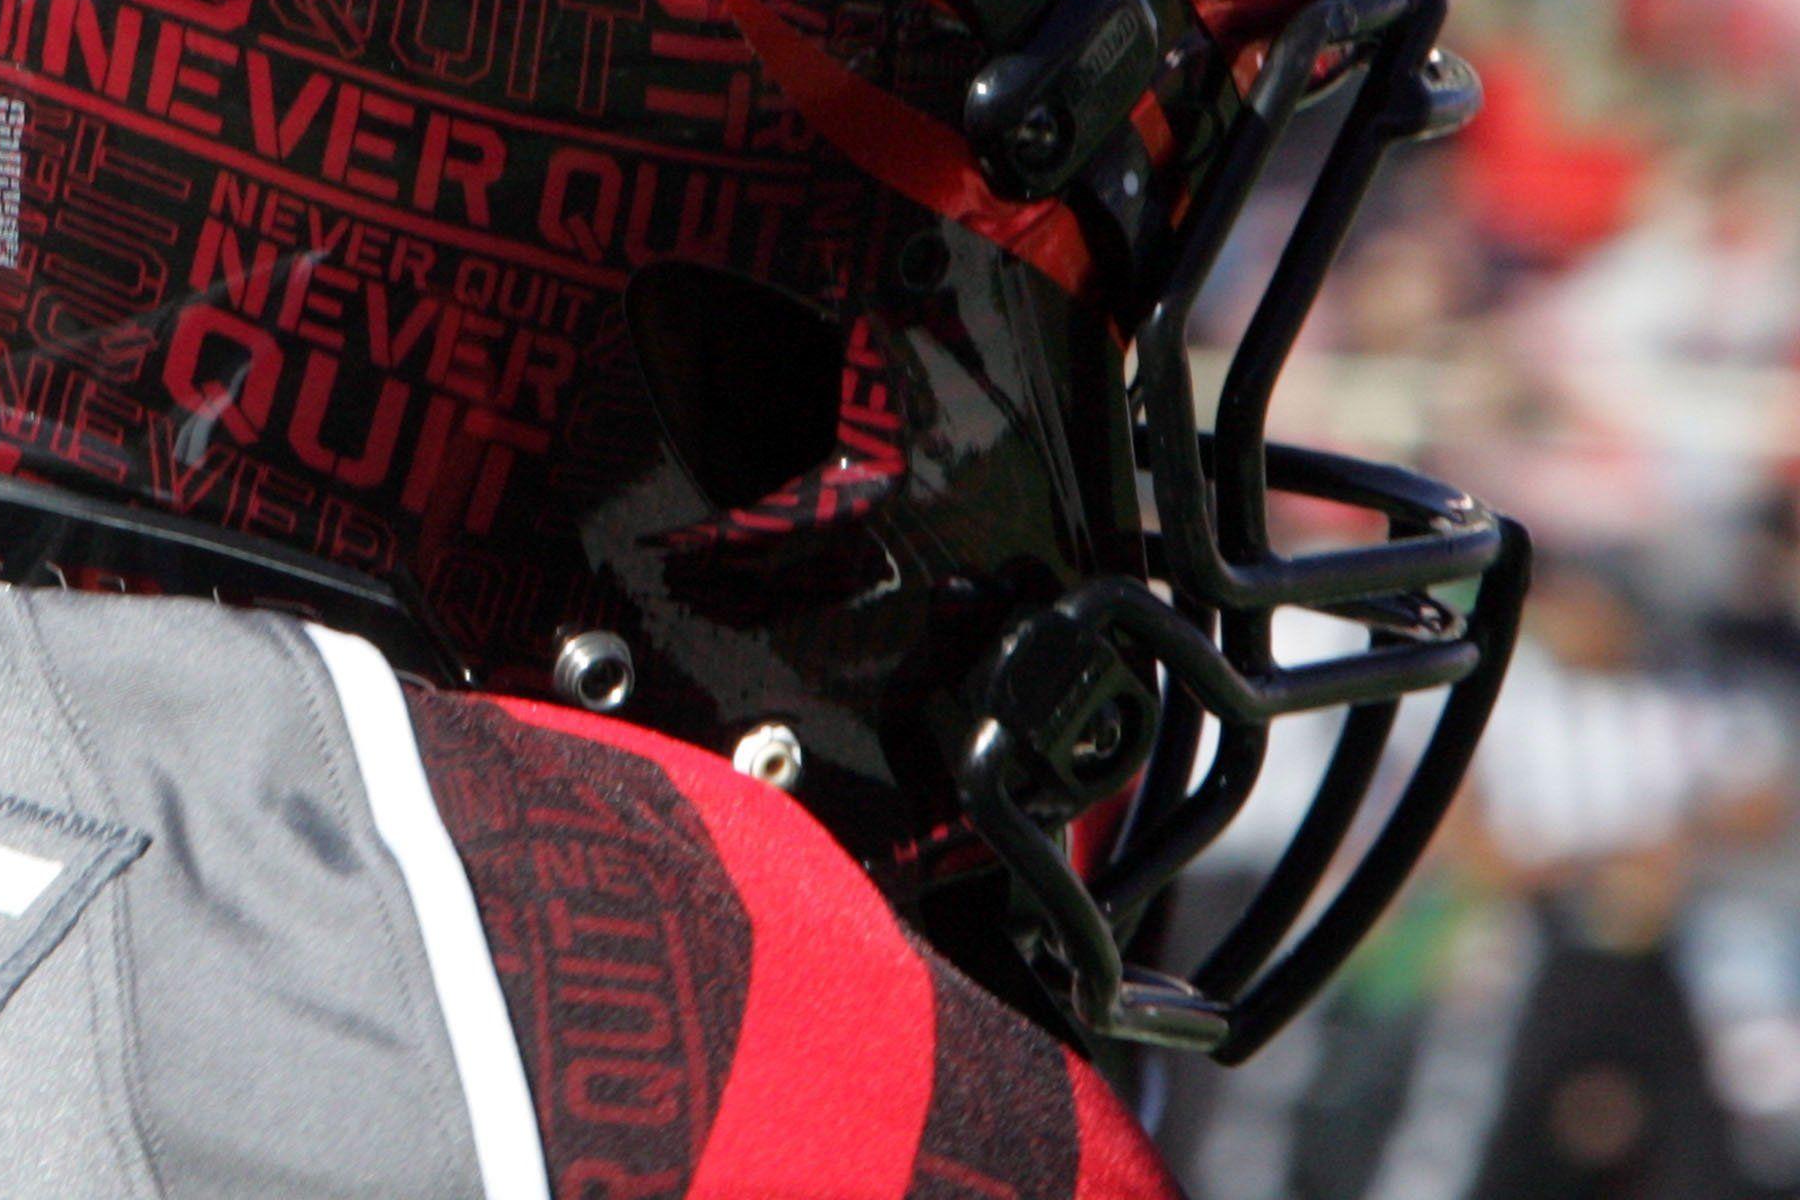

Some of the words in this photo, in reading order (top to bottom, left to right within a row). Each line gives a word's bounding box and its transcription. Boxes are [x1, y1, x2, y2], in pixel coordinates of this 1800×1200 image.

[186, 213, 582, 422] NEVER
[206, 170, 442, 293] NEVER
[452, 254, 598, 336] QUIT
[162, 303, 552, 538] QUIT
